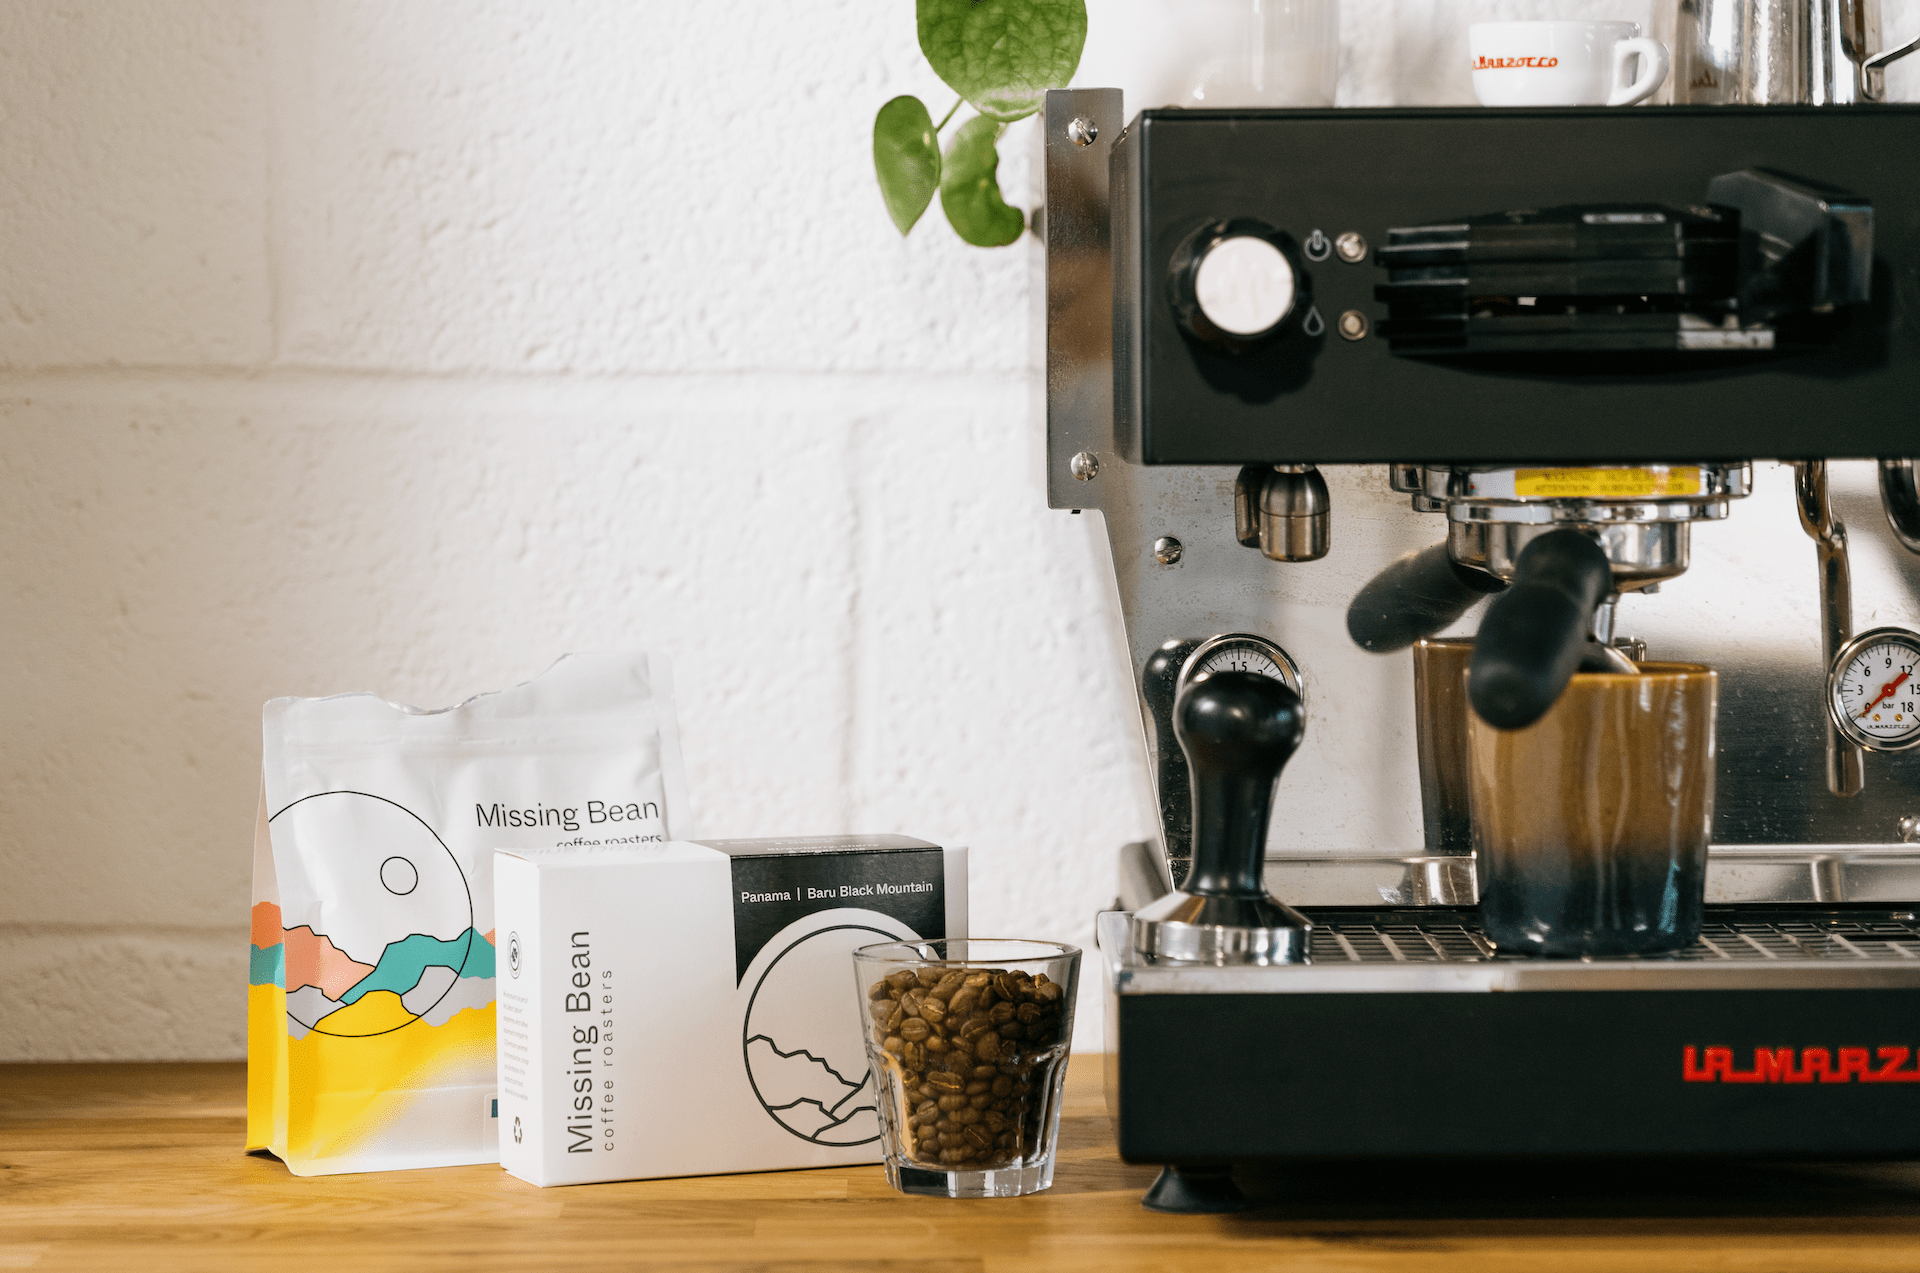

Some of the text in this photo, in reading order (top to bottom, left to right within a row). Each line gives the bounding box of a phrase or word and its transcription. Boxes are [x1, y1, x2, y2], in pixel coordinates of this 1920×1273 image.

[1885, 658, 1892, 668] 9
[1864, 666, 1871, 677] 6
[1900, 665, 1913, 676] 12
[1857, 684, 1864, 695] 3
[1901, 702, 1914, 713] 18
[476, 800, 659, 831] Missing Bean
[605, 834, 662, 845] roasters
[741, 891, 791, 903] Panama
[807, 886, 836, 900] Baru
[840, 884, 874, 897] Black
[876, 881, 933, 895] Mountain
[566, 931, 598, 1154] Missing Bean
[601, 970, 614, 1151] coffee roasters
[1683, 1044, 1920, 1083] LA MARZ
